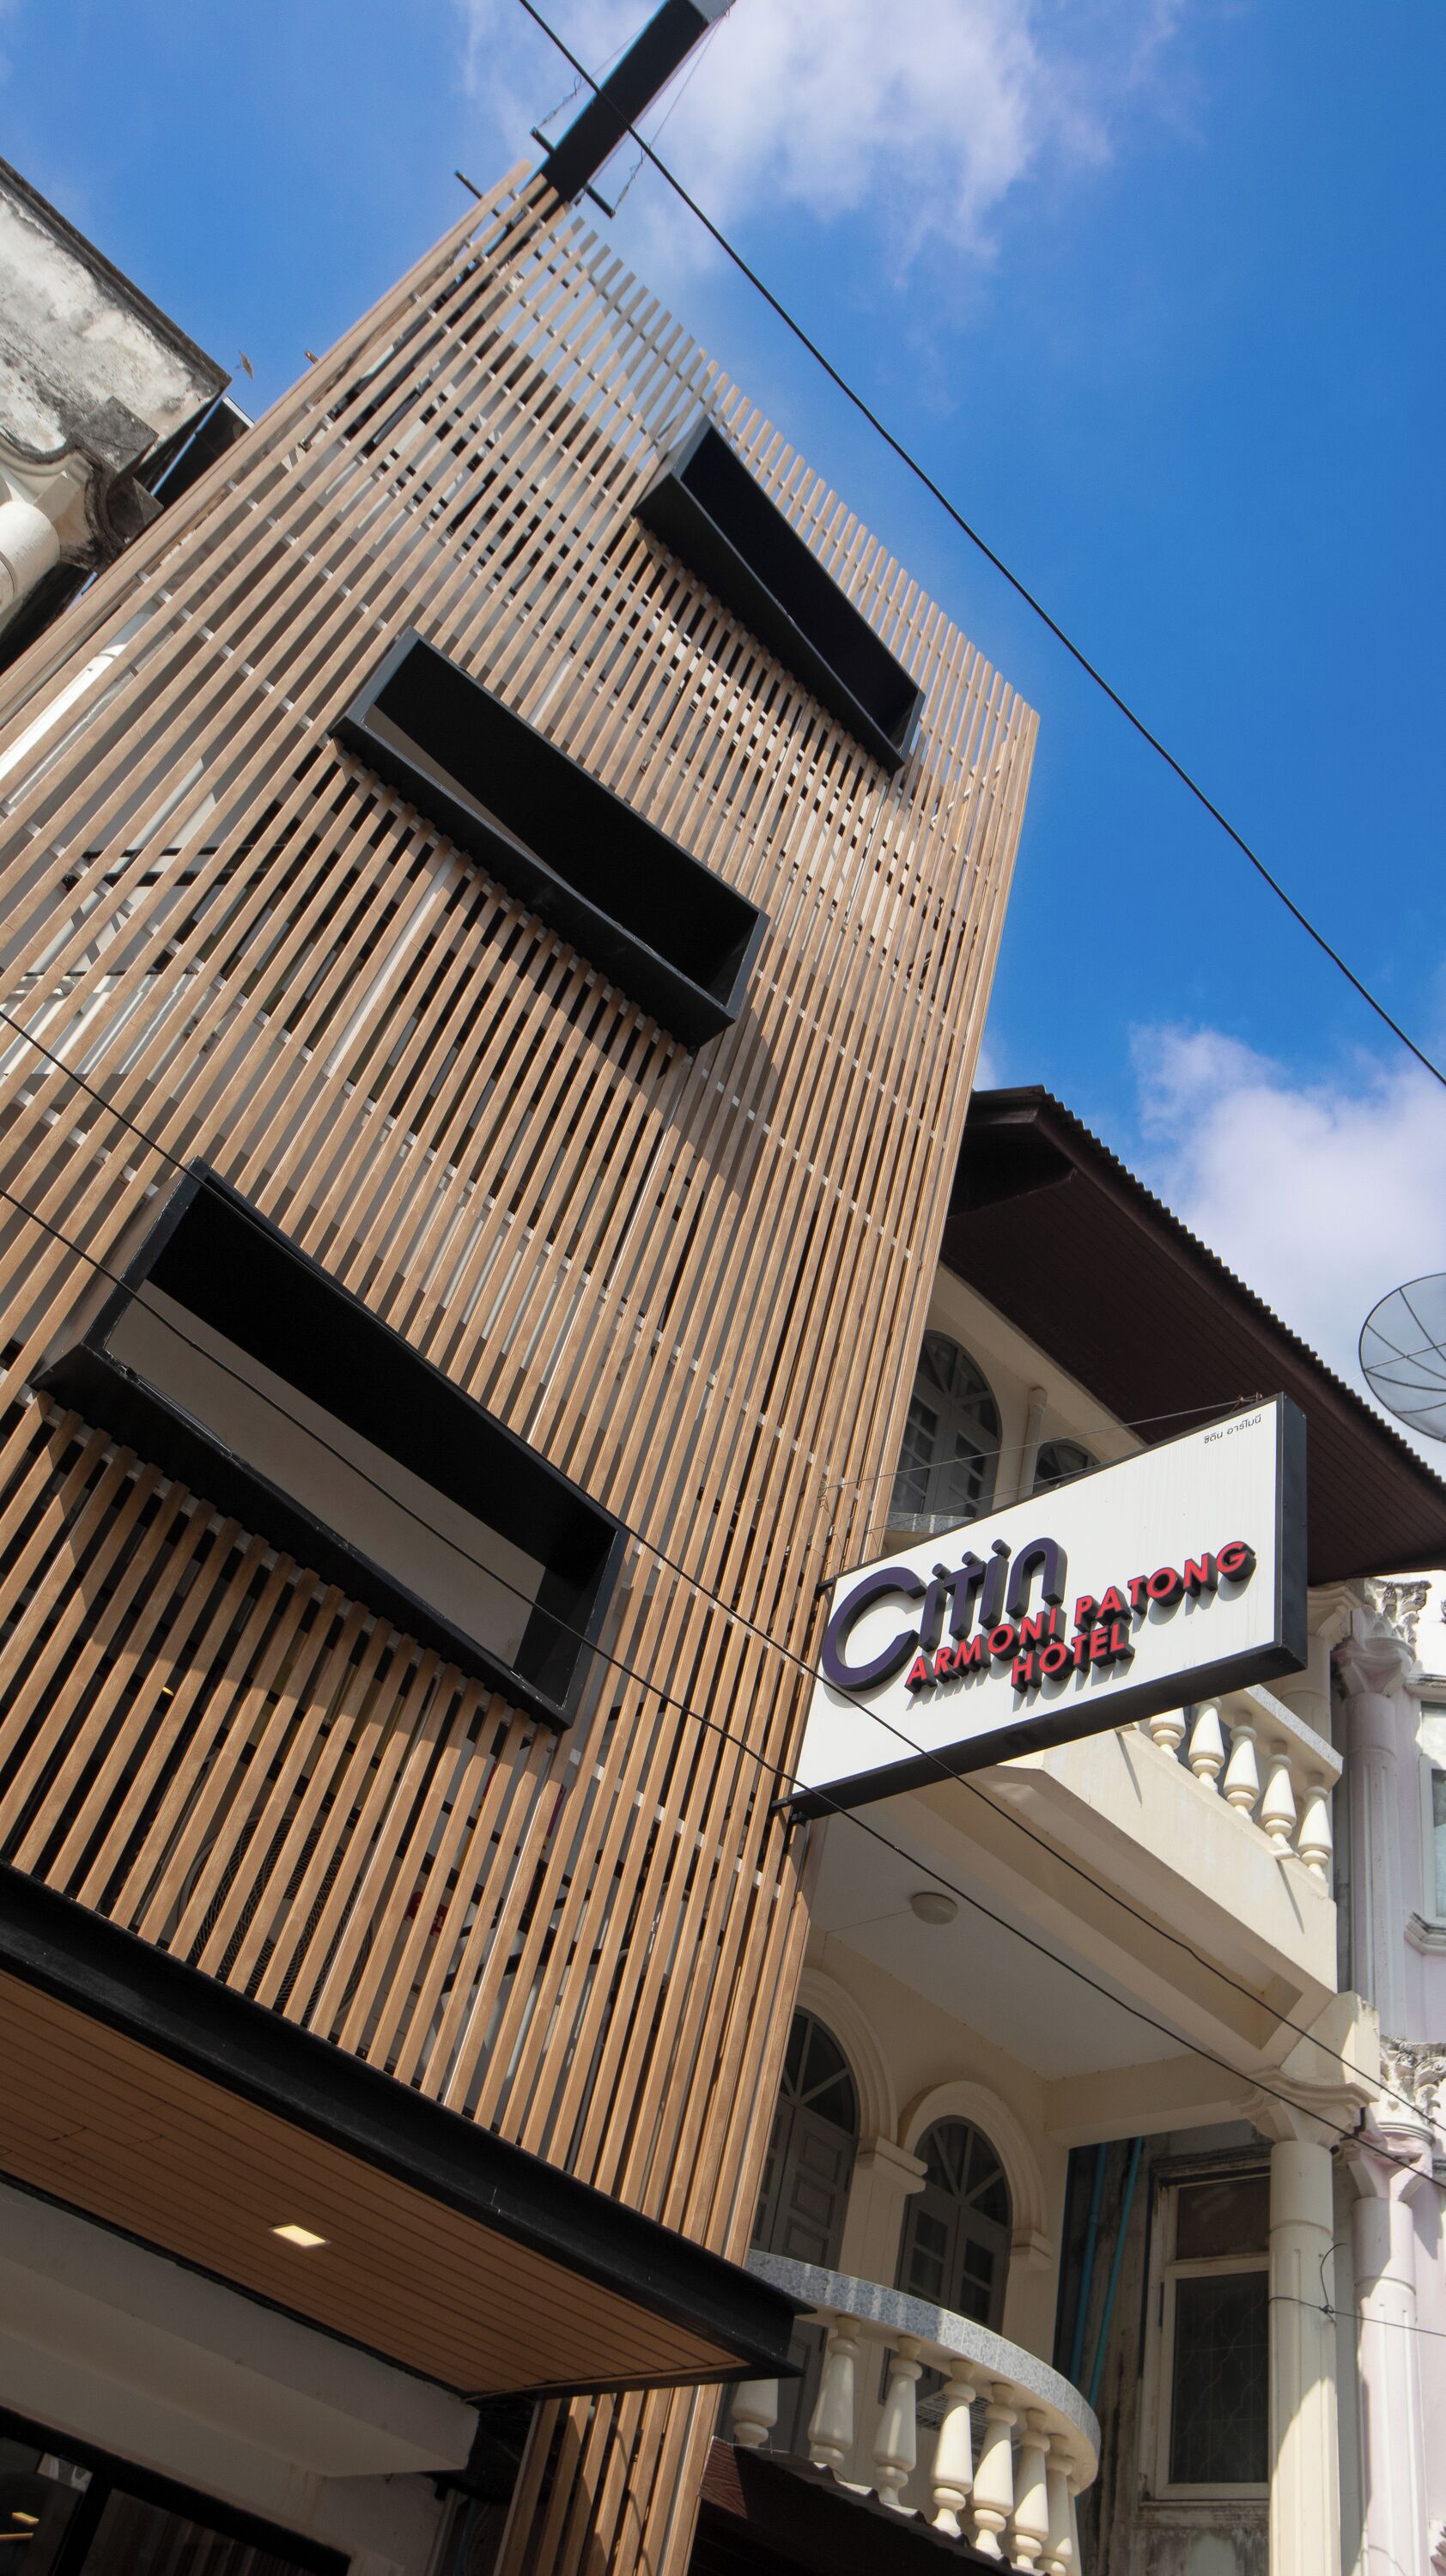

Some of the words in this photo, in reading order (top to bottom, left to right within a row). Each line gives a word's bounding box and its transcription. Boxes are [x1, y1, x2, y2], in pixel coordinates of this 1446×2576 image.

[905, 1607, 1065, 1693] ARMONI
[1074, 1540, 1255, 1630] PATONG
[1012, 1622, 1133, 1692] HOTEL
